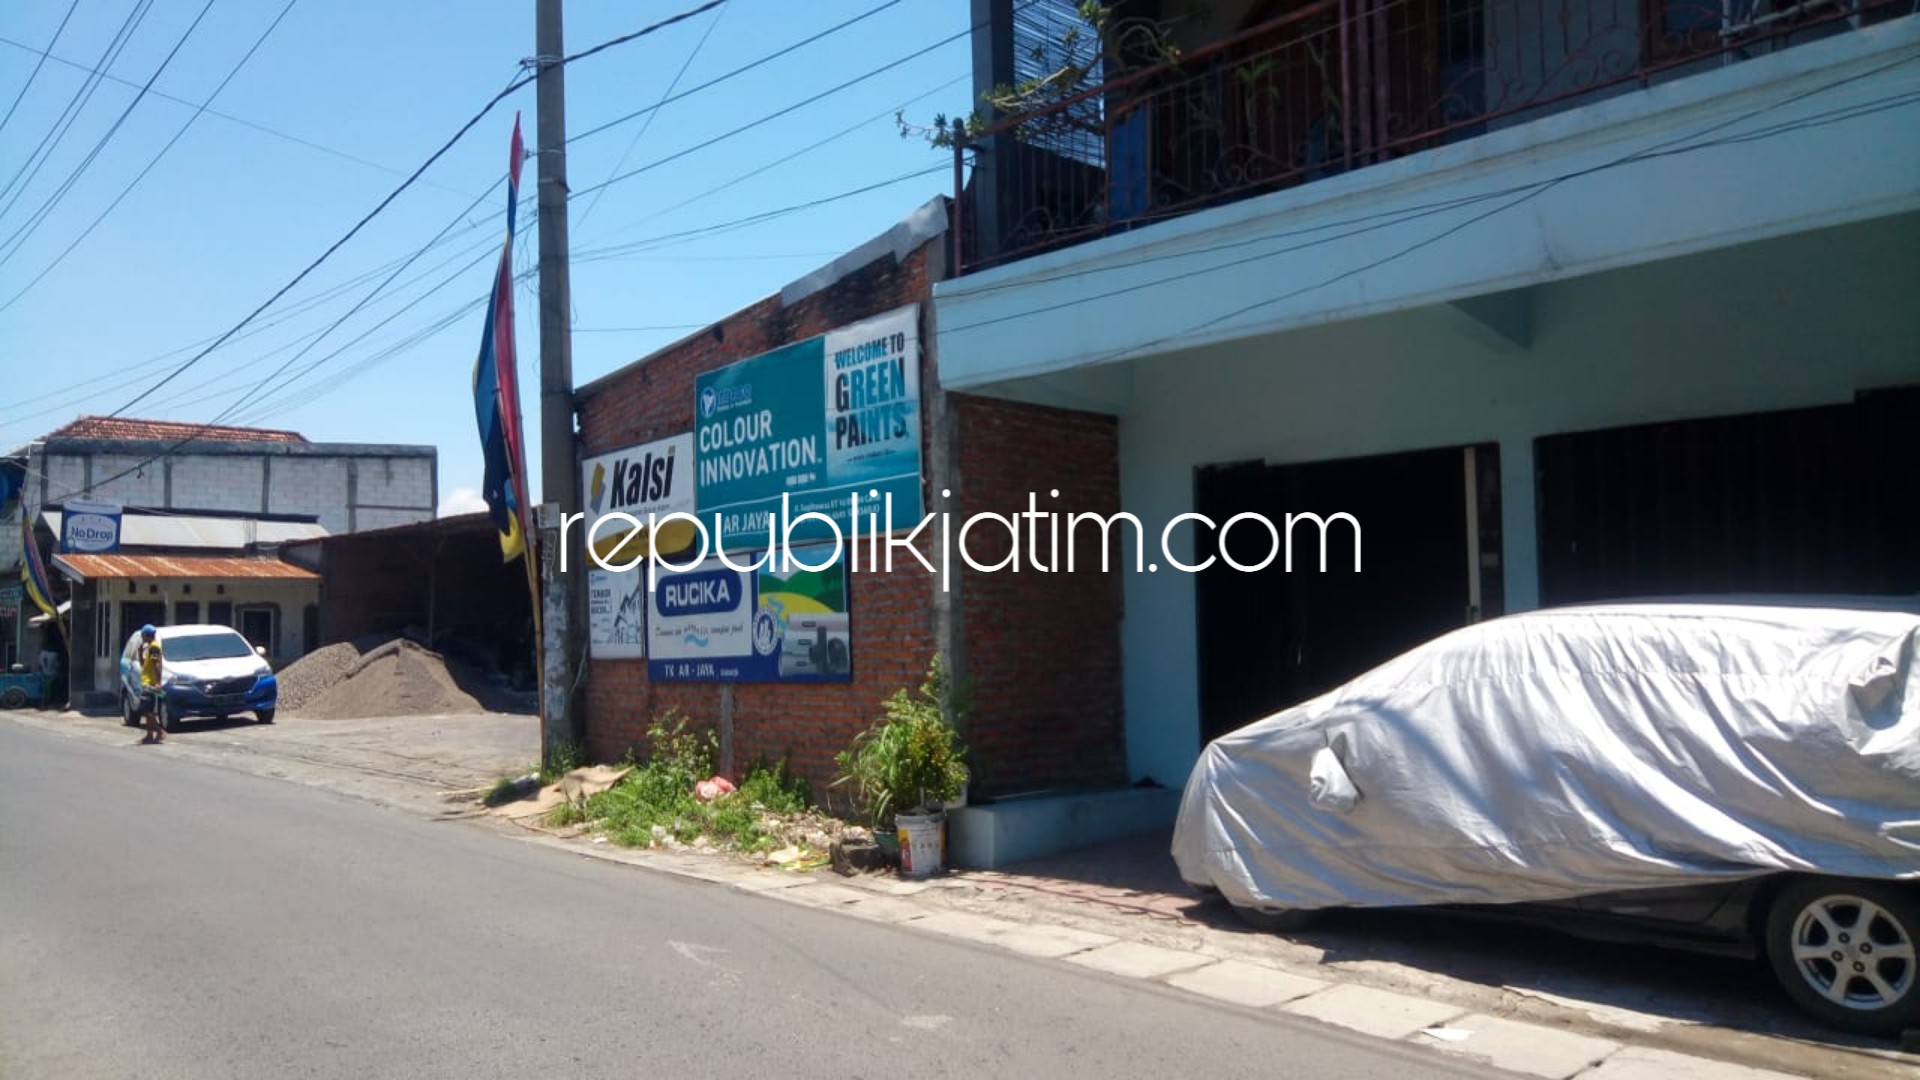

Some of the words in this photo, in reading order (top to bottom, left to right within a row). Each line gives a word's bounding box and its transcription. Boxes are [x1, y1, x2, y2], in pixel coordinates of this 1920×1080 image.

[835, 337, 888, 370] WELCOME
[889, 331, 904, 354] TO
[835, 357, 905, 413] GREEN
[700, 409, 772, 453] COLOUR
[610, 444, 675, 509] Kalsi
[724, 515, 739, 534] AR
[742, 510, 770, 532] JAYA
[665, 579, 731, 608] RUCIKA
